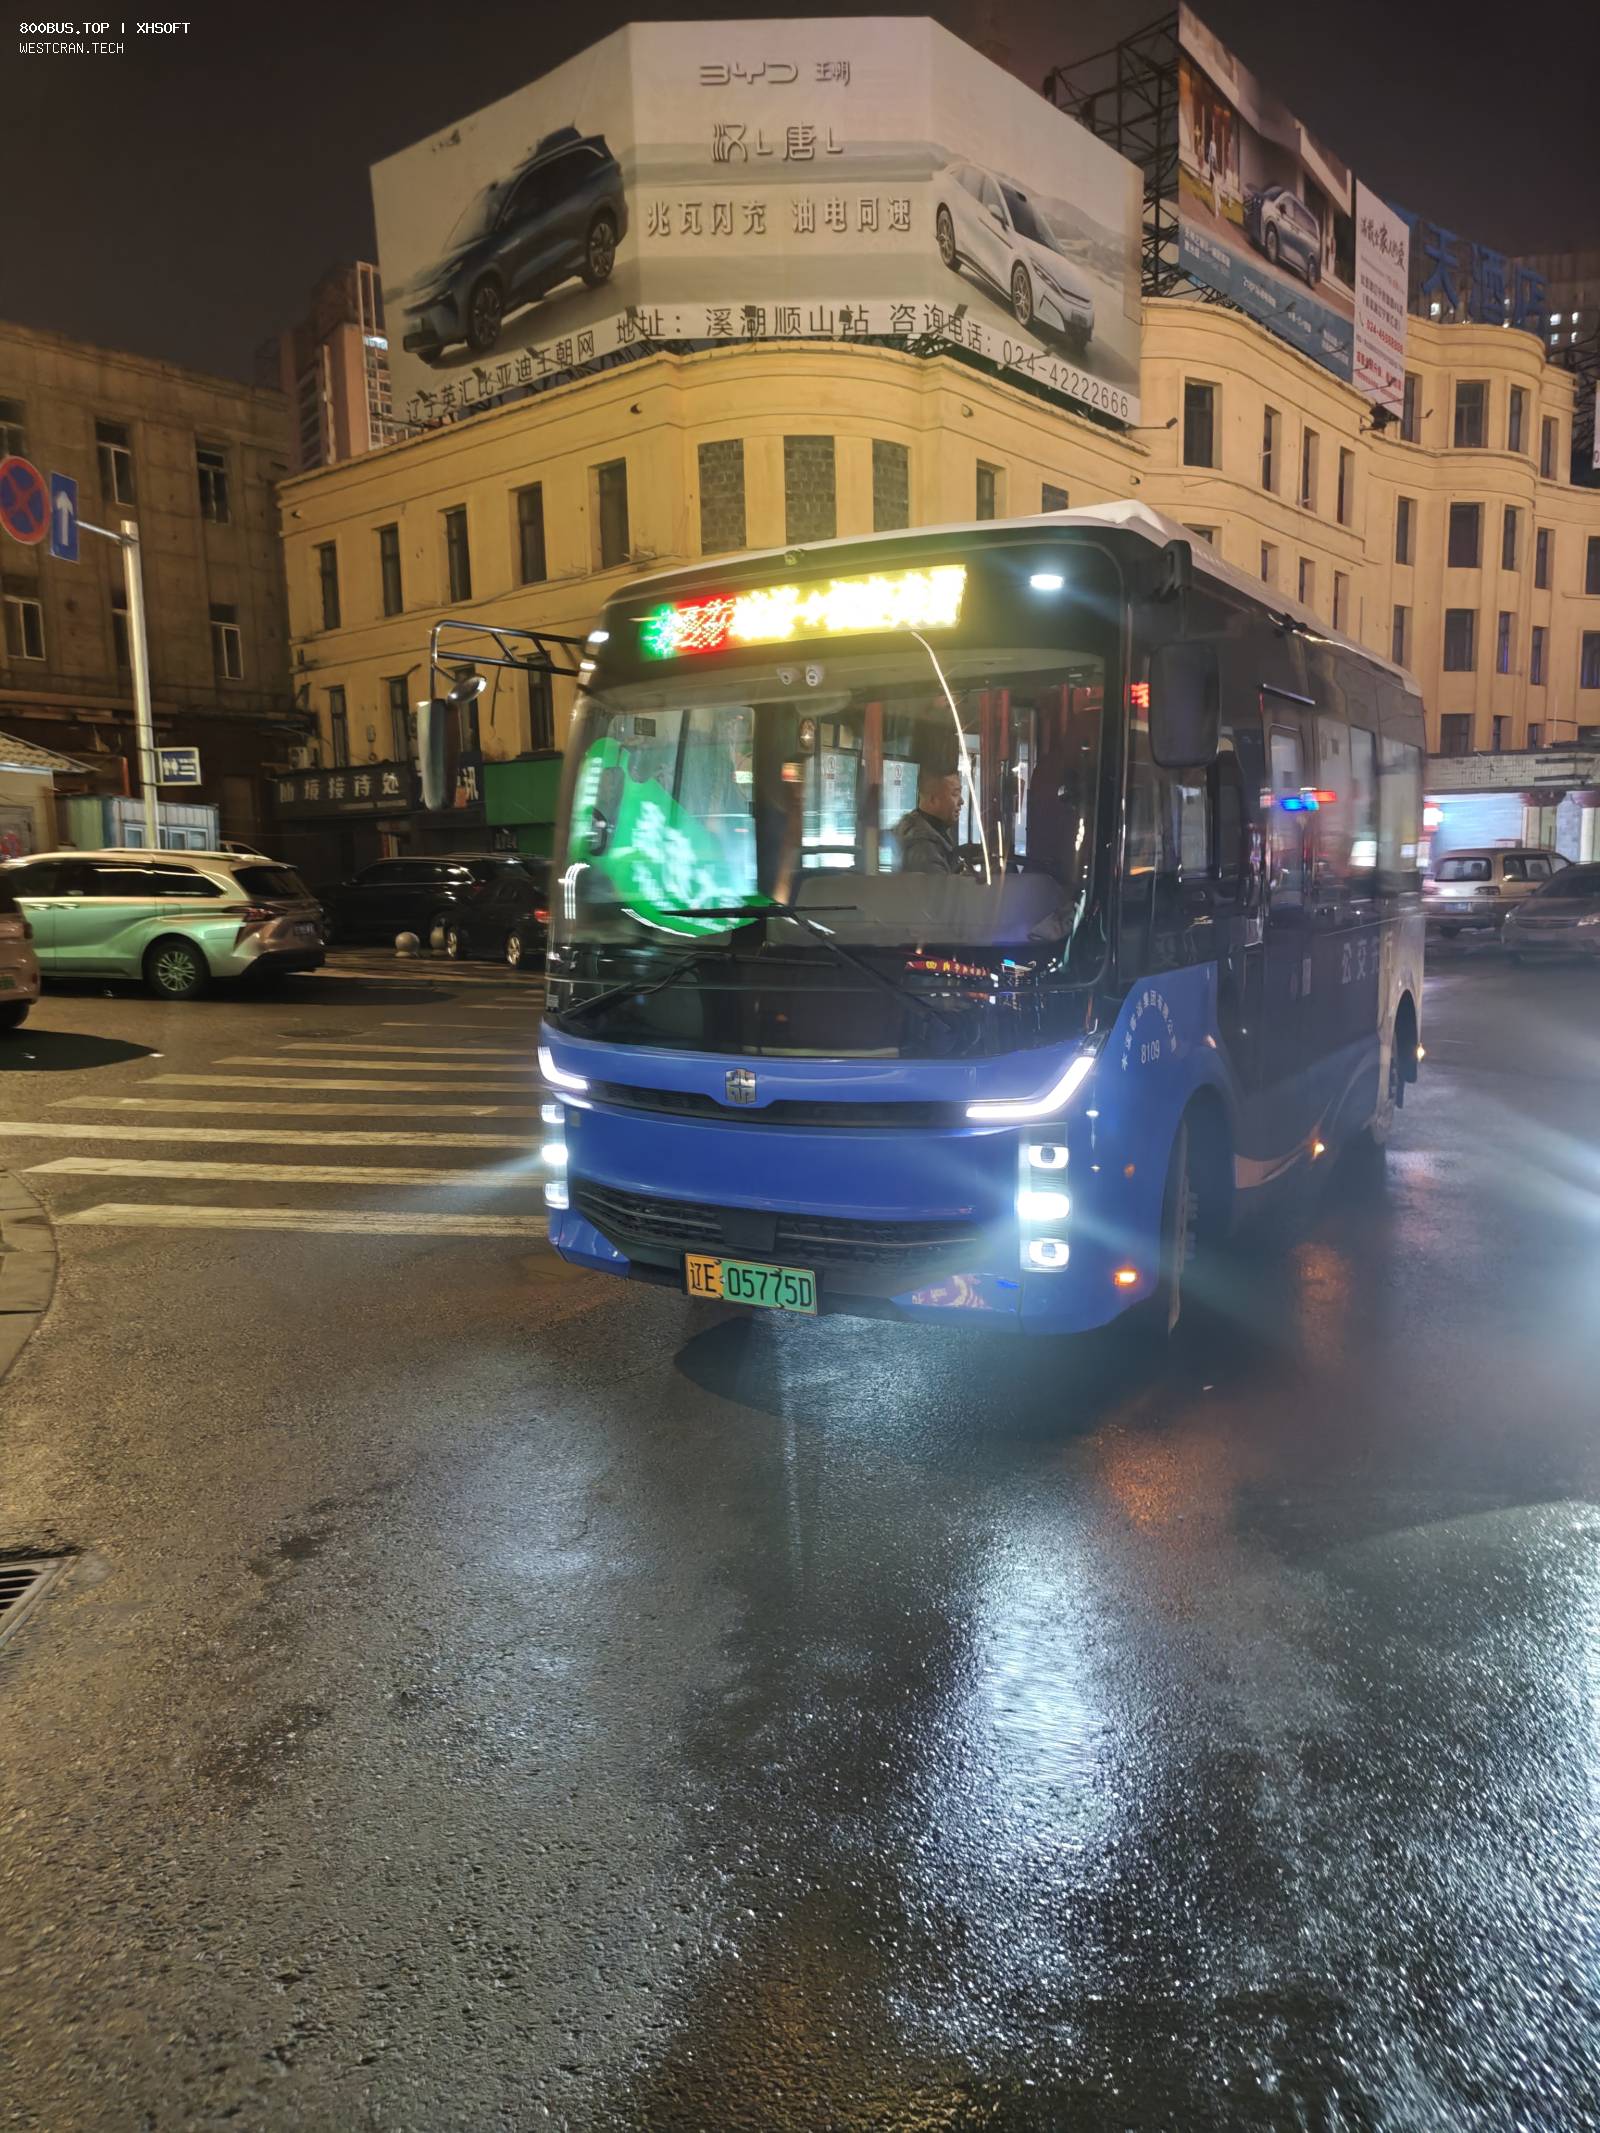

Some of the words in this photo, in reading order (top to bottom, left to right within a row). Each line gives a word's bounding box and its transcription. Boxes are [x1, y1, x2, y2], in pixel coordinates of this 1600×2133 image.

[700, 61, 798, 86] BYD
[648, 199, 769, 237] 兆瓦闪充
[791, 194, 912, 235] 油电同速
[1140, 1039, 1161, 1065] 8109
